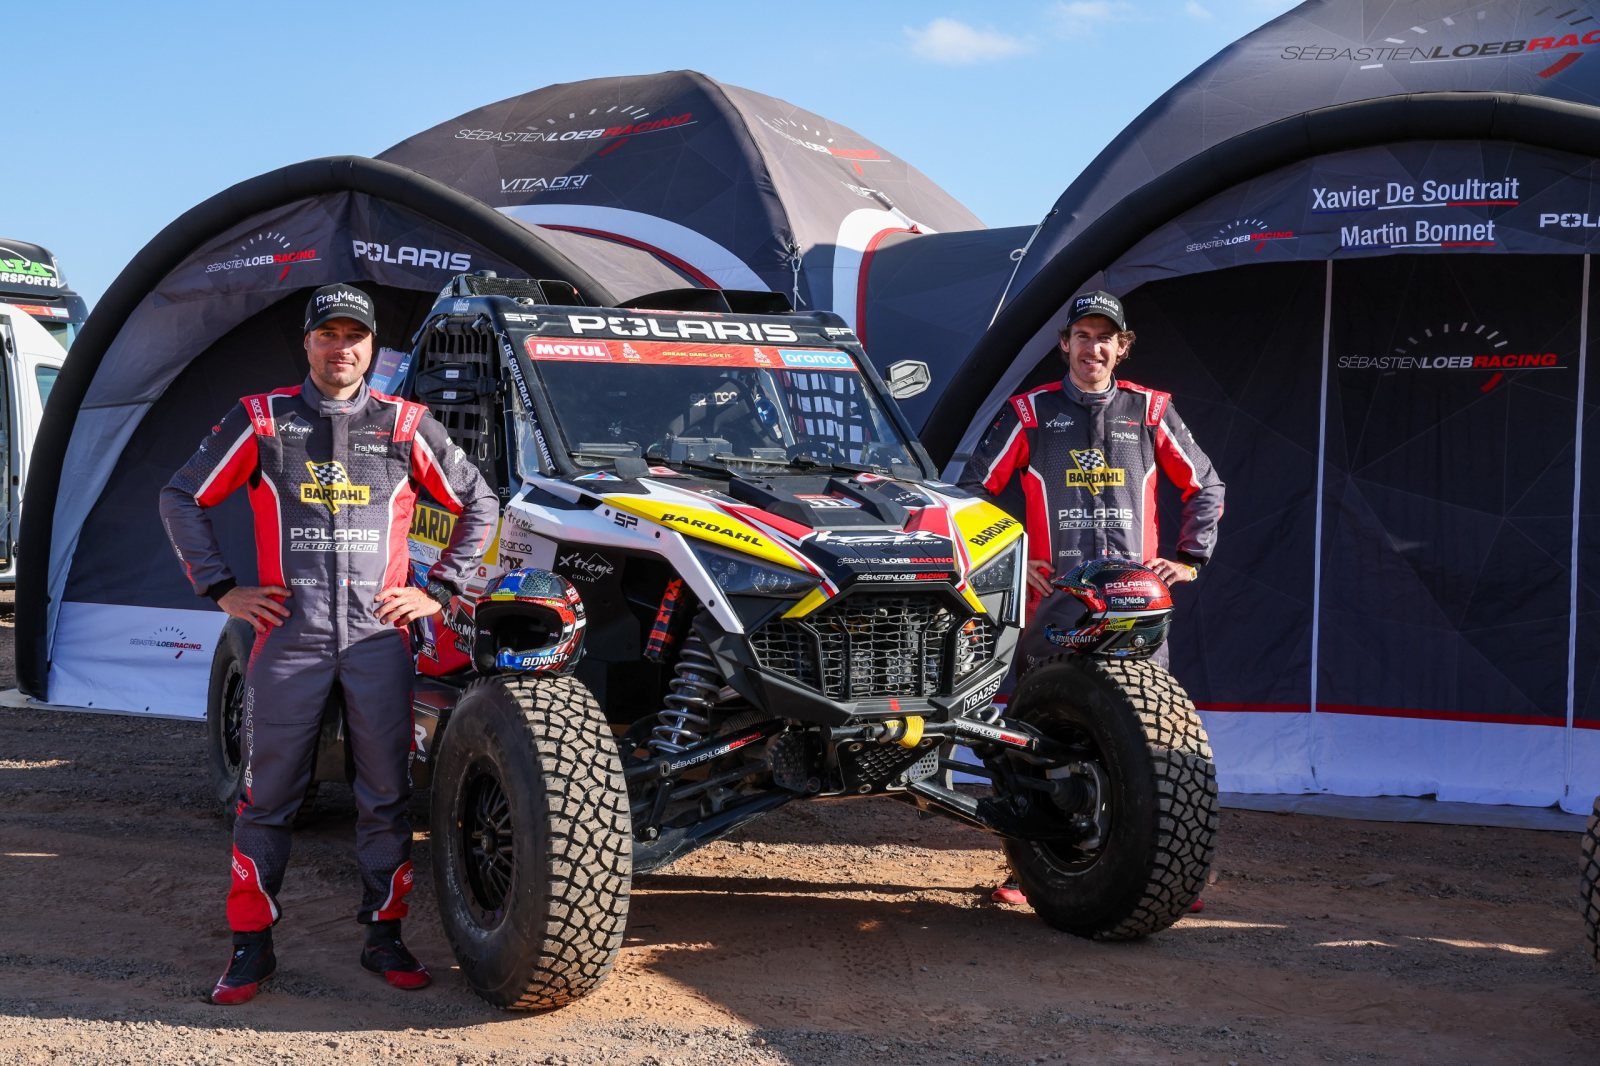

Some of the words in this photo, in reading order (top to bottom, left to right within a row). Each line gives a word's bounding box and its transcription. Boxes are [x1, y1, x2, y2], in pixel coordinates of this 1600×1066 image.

[500, 174, 589, 190] VITABRI
[1312, 185, 1380, 209] Xavier
[1387, 183, 1415, 203] De
[1422, 177, 1519, 200] Soultrait
[1539, 213, 1600, 228] POL
[1341, 222, 1407, 247] Martin
[1415, 220, 1495, 242] Bonnet
[352, 240, 472, 271] POLARIS
[567, 315, 798, 343] POLARIS
[503, 344, 514, 357] DE
[535, 343, 606, 357] MOTUL
[785, 353, 848, 365] aramco
[508, 356, 532, 408] SOULTRAIT
[534, 429, 556, 471] BONNET
[1069, 472, 1122, 483] BARDAHL
[304, 487, 366, 501] BARDAHL
[614, 512, 639, 530] SP
[1058, 508, 1133, 519] POLARIS
[290, 527, 380, 541] POLARIS
[660, 513, 763, 547] BARDAHL
[571, 573, 596, 583] COLOR
[1105, 580, 1153, 589] POLARIS
[522, 652, 564, 667] BONNET
